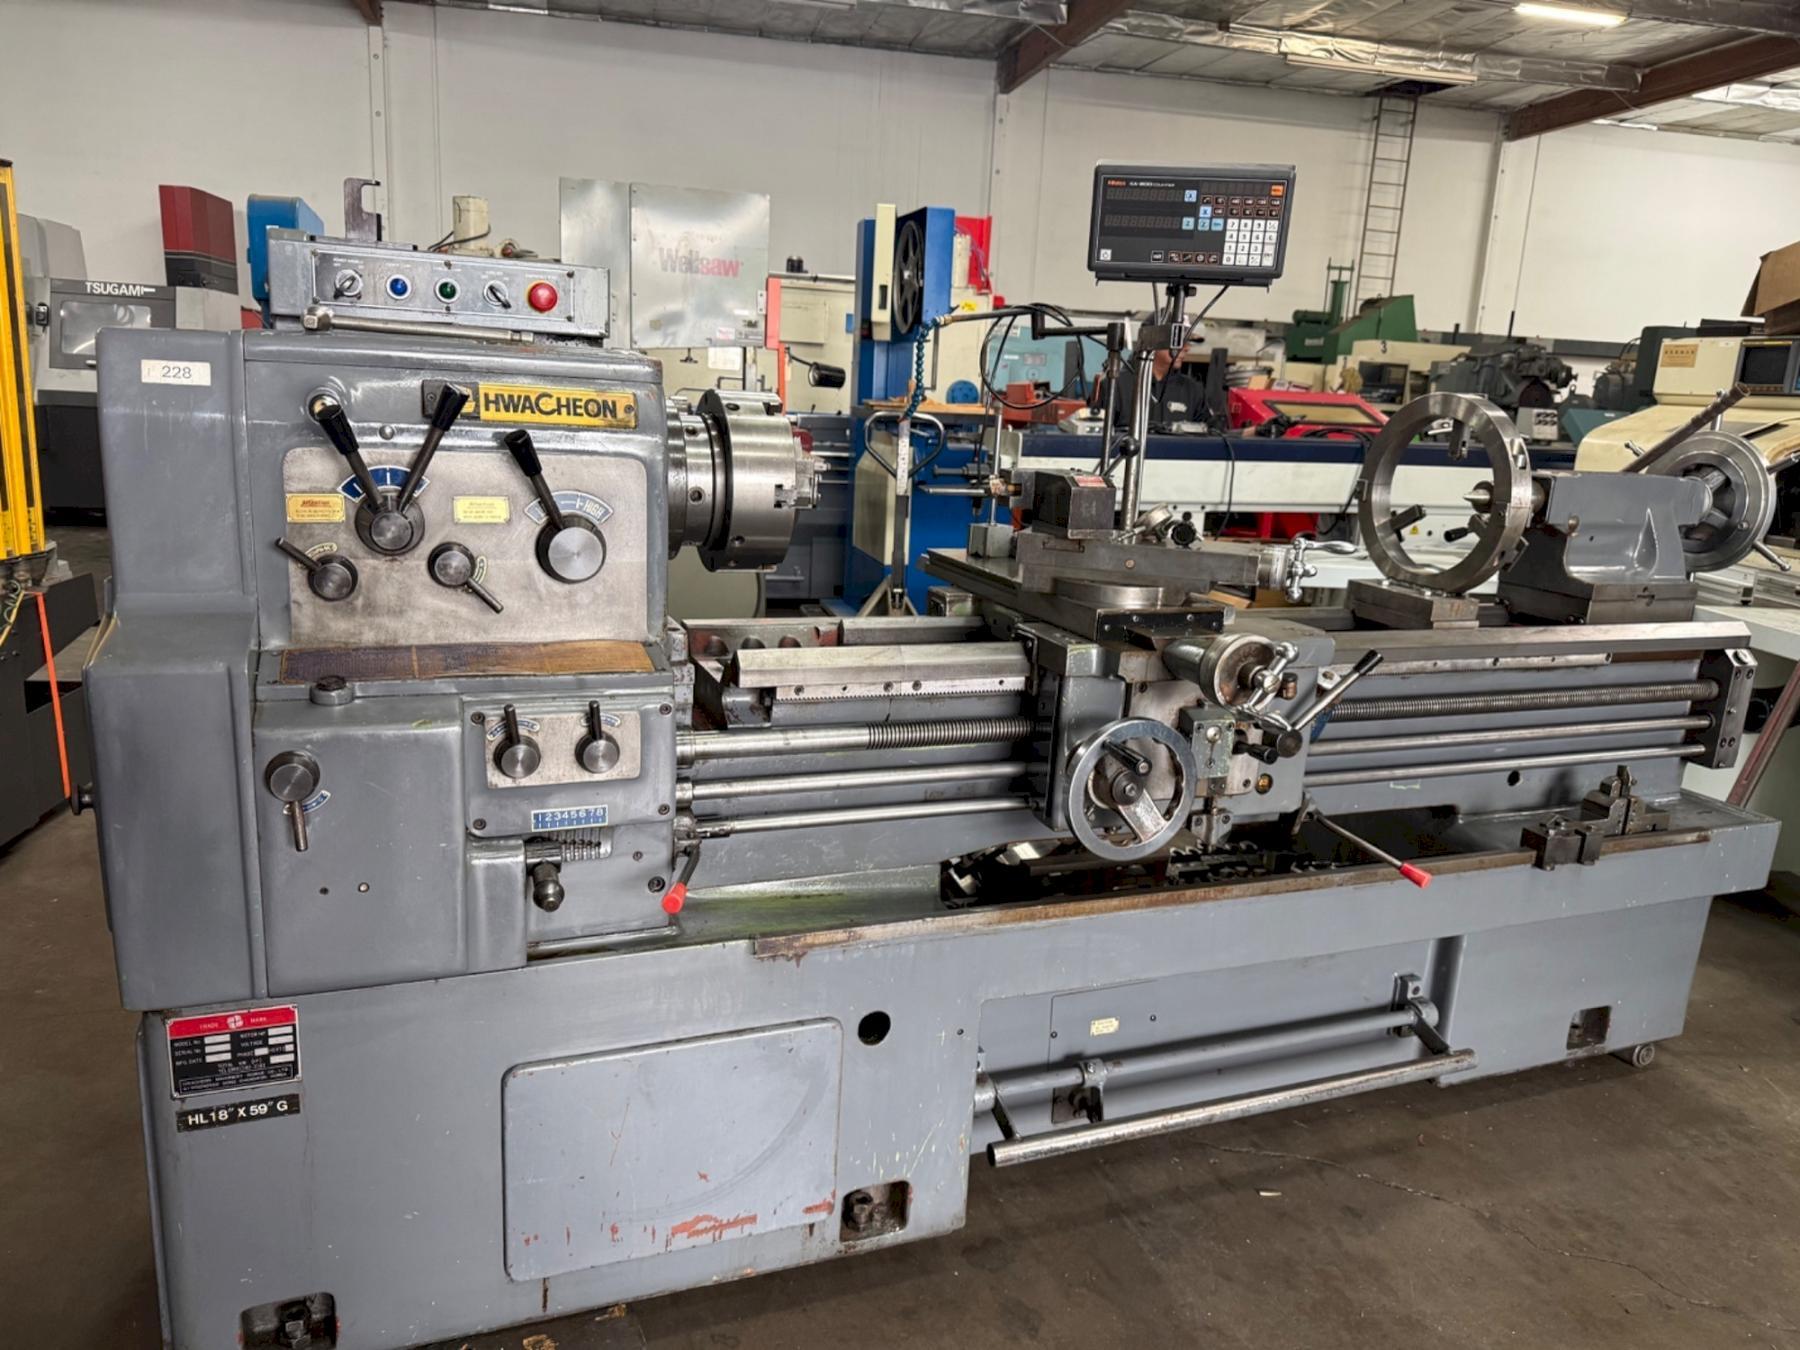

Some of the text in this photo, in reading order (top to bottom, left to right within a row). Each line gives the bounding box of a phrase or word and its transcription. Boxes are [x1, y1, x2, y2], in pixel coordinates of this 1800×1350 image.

[161, 365, 192, 379] 228
[484, 391, 617, 418] HWACHEON
[237, 1106, 247, 1118] X
[276, 1100, 288, 1112] G
